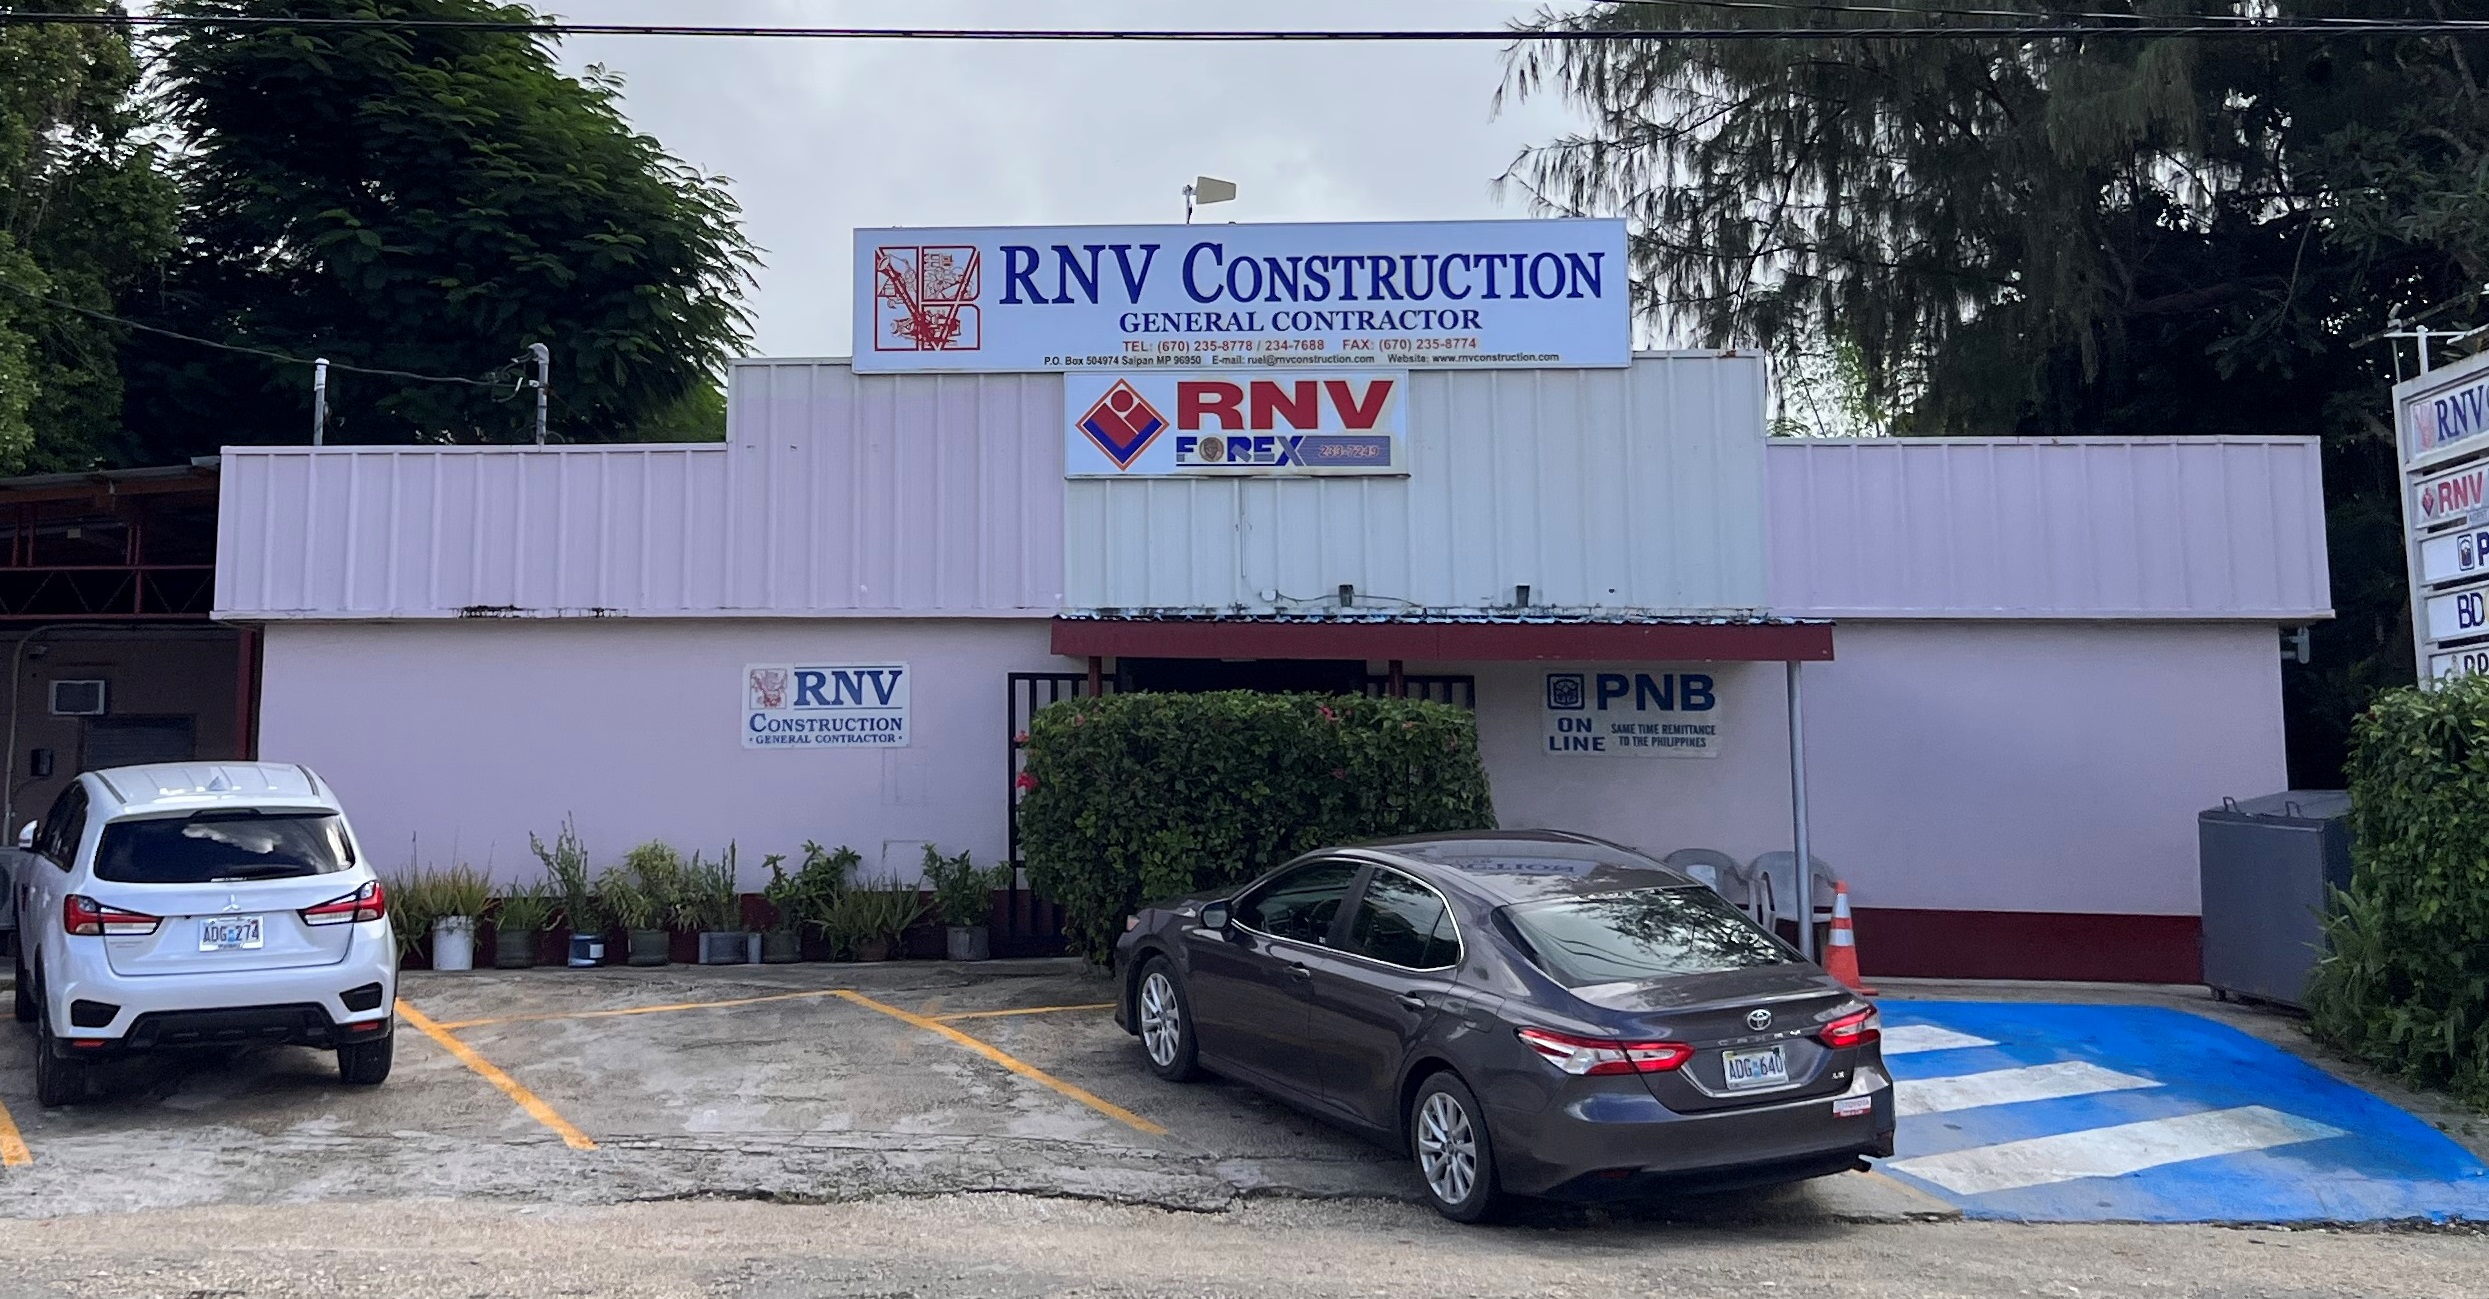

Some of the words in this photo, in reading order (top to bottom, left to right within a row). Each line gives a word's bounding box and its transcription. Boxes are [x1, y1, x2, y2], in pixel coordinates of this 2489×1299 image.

[999, 244, 1161, 305] RNV
[1182, 241, 1606, 305] CONSTRUCTION
[1119, 310, 1264, 333] GENERAL
[1271, 308, 1484, 332] CONTRACTOR
[1122, 341, 1153, 352] TEL:
[1157, 340, 1190, 354] (670)
[1194, 340, 1253, 352] 235-8778
[1265, 339, 1325, 351] 234-7688
[1342, 338, 1374, 351] FAX:
[1379, 338, 1412, 351] (670)
[1416, 338, 1477, 350] 235-8774
[1065, 356, 1084, 366] Box
[1086, 356, 1119, 366] 504974
[1122, 355, 1154, 367] Saipan
[1156, 355, 1172, 365] MP
[1174, 355, 1202, 365] 96950
[1212, 354, 1246, 365] E-mail:
[1387, 353, 1430, 364] Website:
[1177, 380, 1394, 430] RNV
[2435, 384, 2484, 442] RNV
[2438, 471, 2483, 514] RNV
[2477, 531, 2489, 567] P
[2457, 592, 2489, 629] BD
[793, 670, 903, 706] RNV
[1596, 673, 1716, 711] PNB
[750, 713, 903, 732] CONSTRUCTION
[1557, 717, 1592, 733] ON
[1611, 723, 1636, 734] SAME
[1638, 723, 1659, 735] TIME
[1662, 724, 1716, 735] REMITTANCE
[755, 734, 812, 744] GENERAL
[815, 733, 896, 743] CONTRACTOR
[1549, 735, 1606, 751] LINE
[1618, 735, 1630, 747] TO
[1632, 735, 1648, 747] THE
[1651, 736, 1706, 748] PHILIPPINES
[1729, 1058, 1753, 1080] ADG
